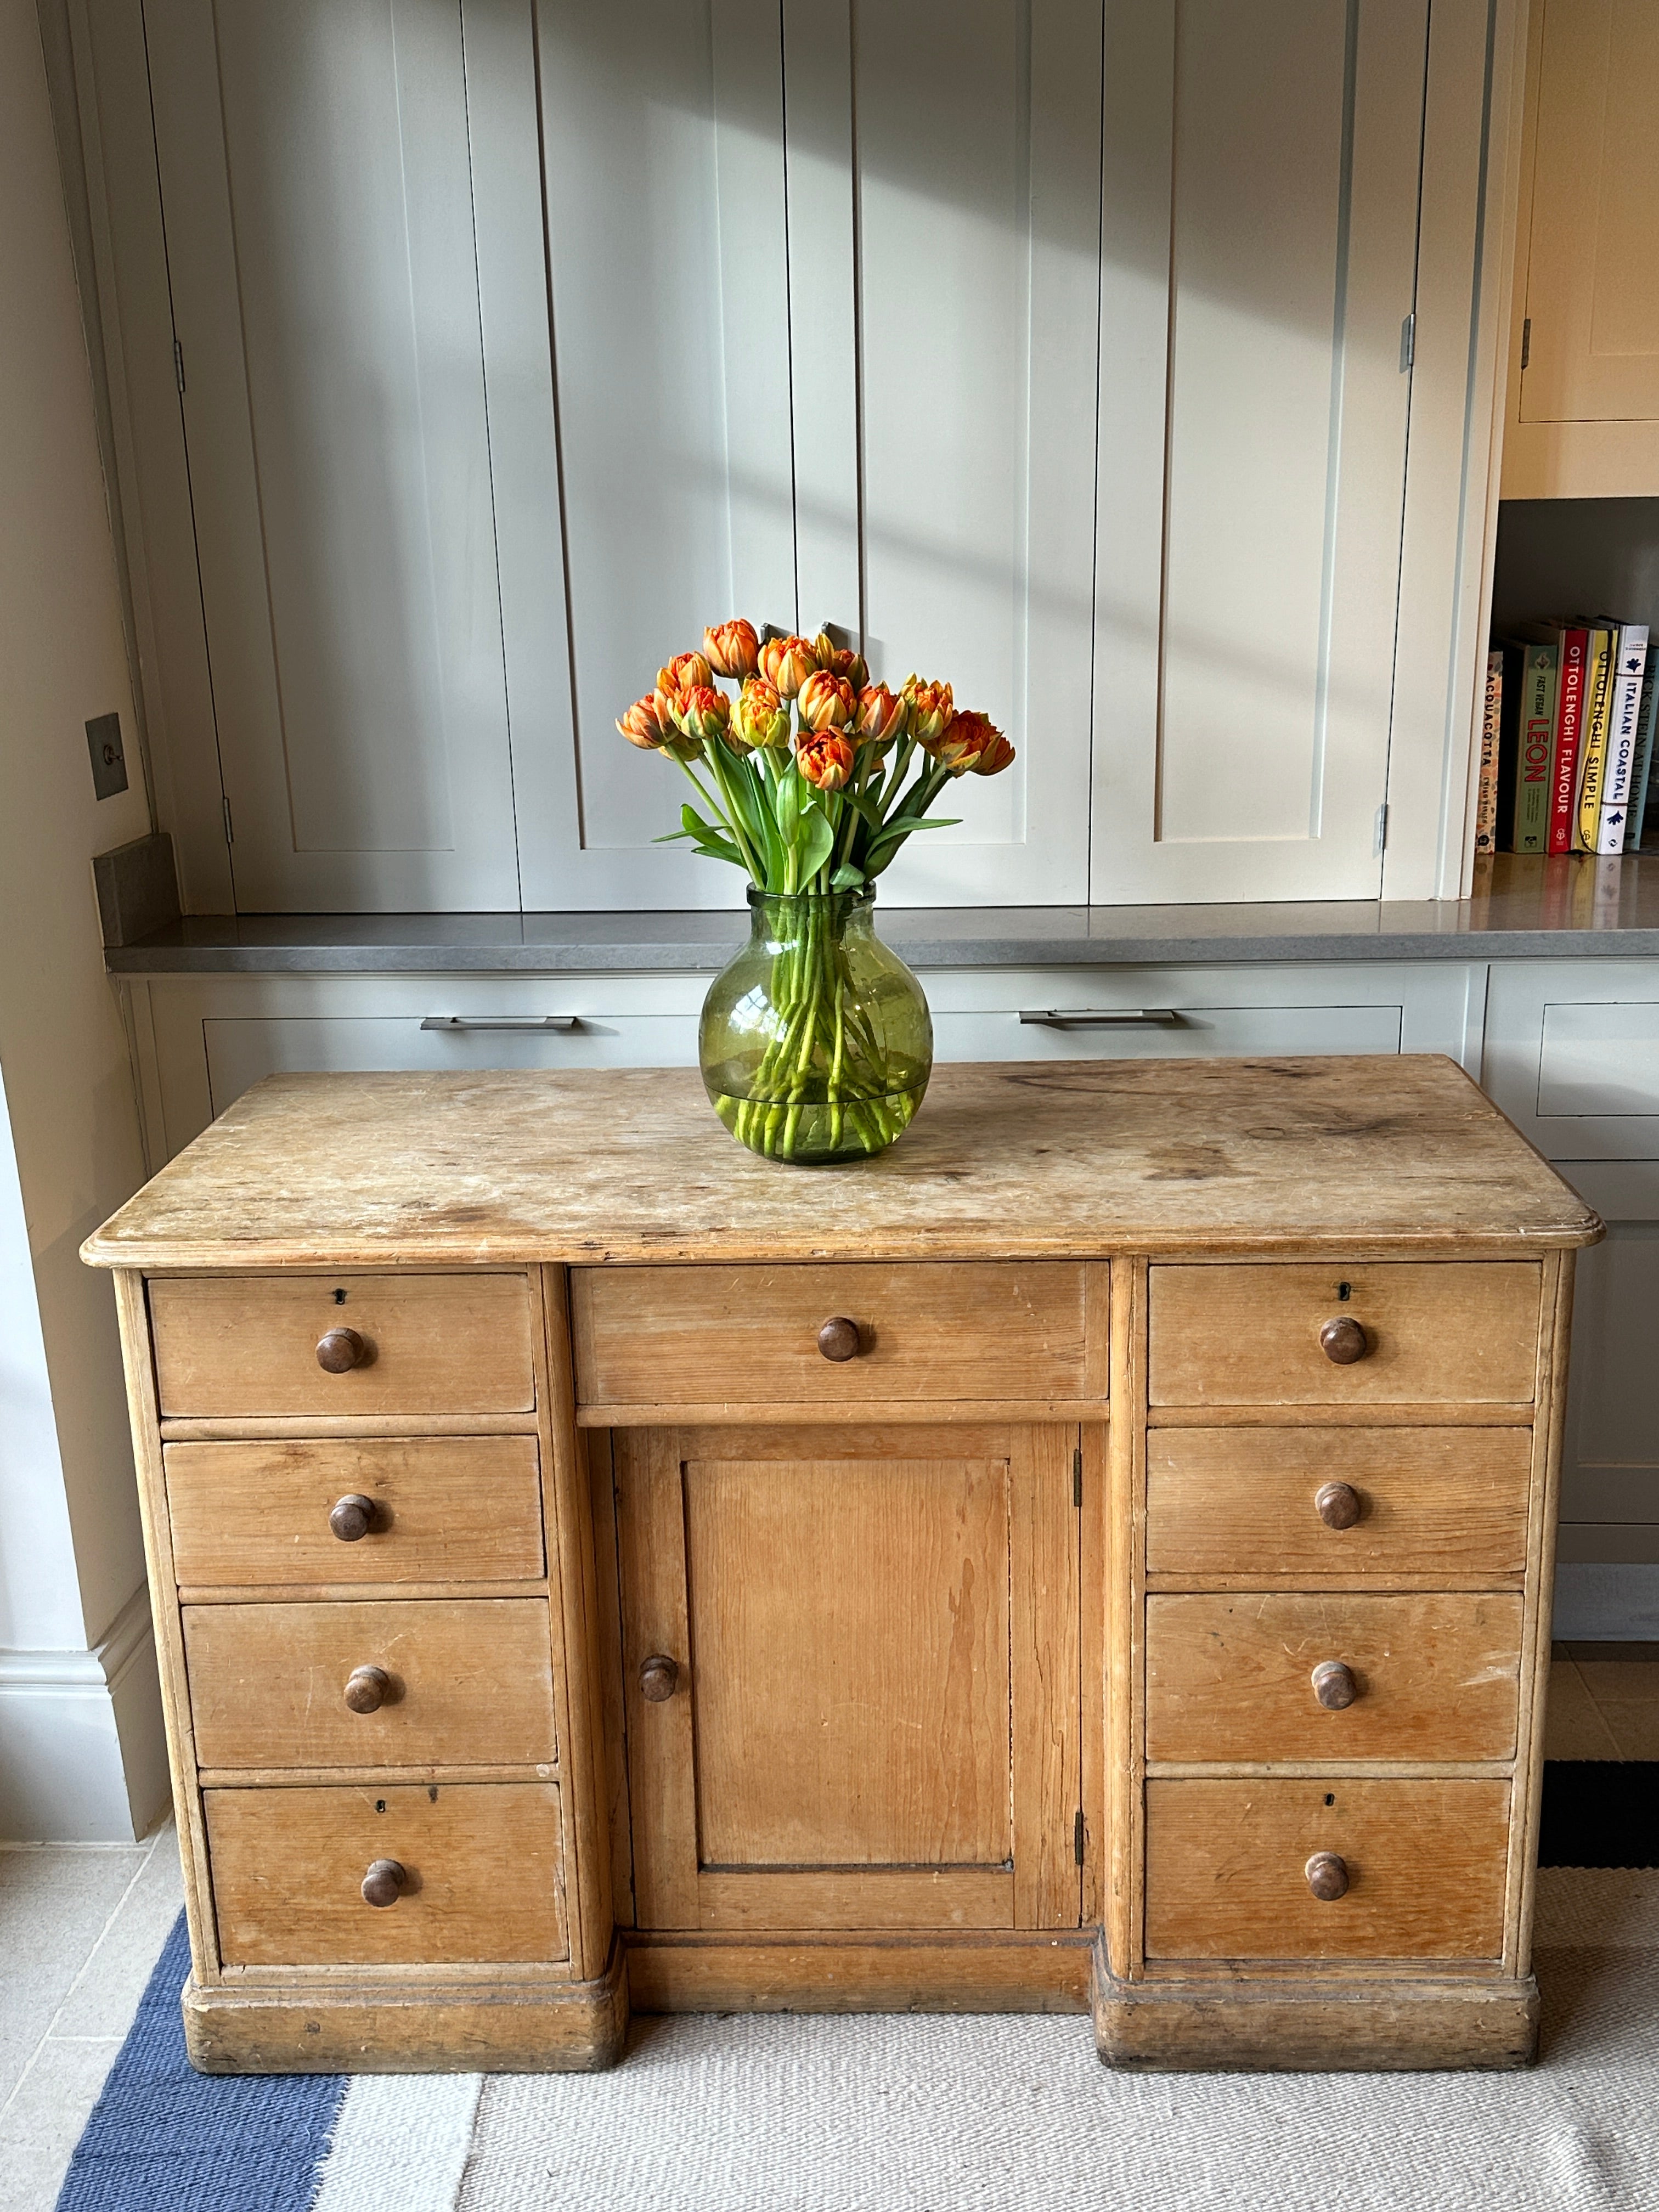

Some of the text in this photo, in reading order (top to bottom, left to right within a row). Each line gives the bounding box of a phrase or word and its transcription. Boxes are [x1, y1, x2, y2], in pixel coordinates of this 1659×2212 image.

[1482, 675, 1495, 766] ACQUACOTTA
[1524, 719, 1549, 782] LEON
[1534, 675, 1546, 715] FAST VEGAN
[1556, 646, 1581, 813] OTTOLENGHI FLAVOUR
[1584, 651, 1608, 809] OTTOLENGHI SIMPLE
[1613, 682, 1638, 800] ITALIAN COASTAL
[1628, 664, 1656, 819] RICK STEIN AT HOME
